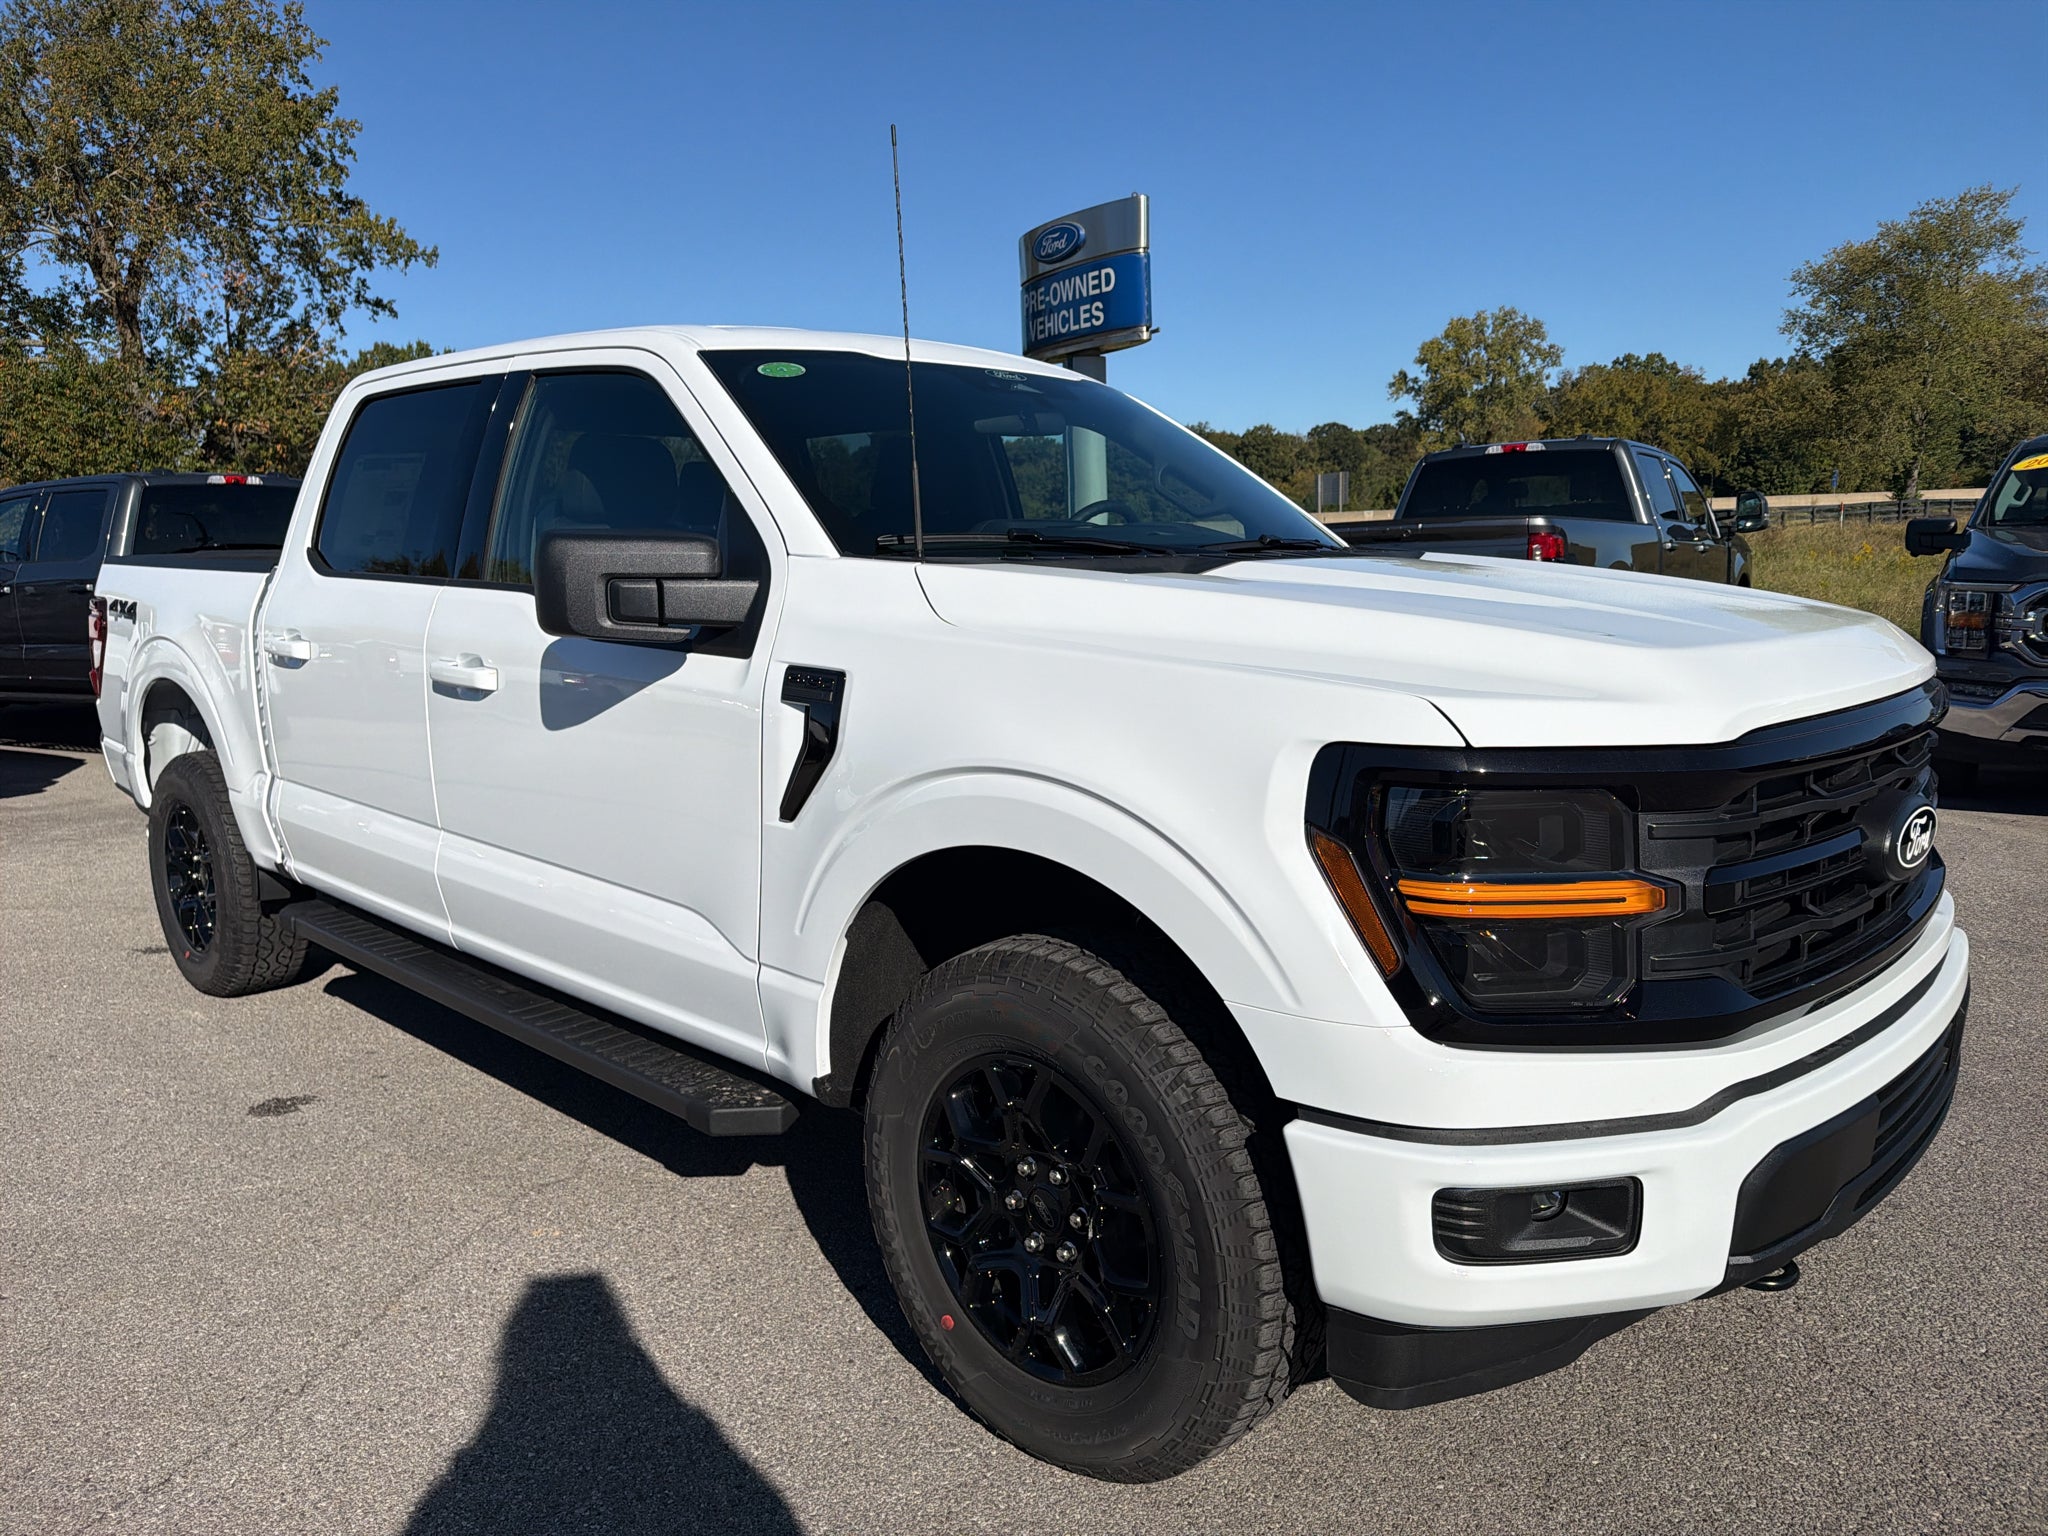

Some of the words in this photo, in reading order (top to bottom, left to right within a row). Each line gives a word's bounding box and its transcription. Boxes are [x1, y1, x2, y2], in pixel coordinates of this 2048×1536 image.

[1041, 232, 1067, 256] Ford
[1024, 267, 1116, 316] PRE-OWNED
[1029, 301, 1105, 342] VEHICLES
[1906, 815, 1932, 861] Ford
[1082, 1055, 1201, 1340] GOODYEAR
